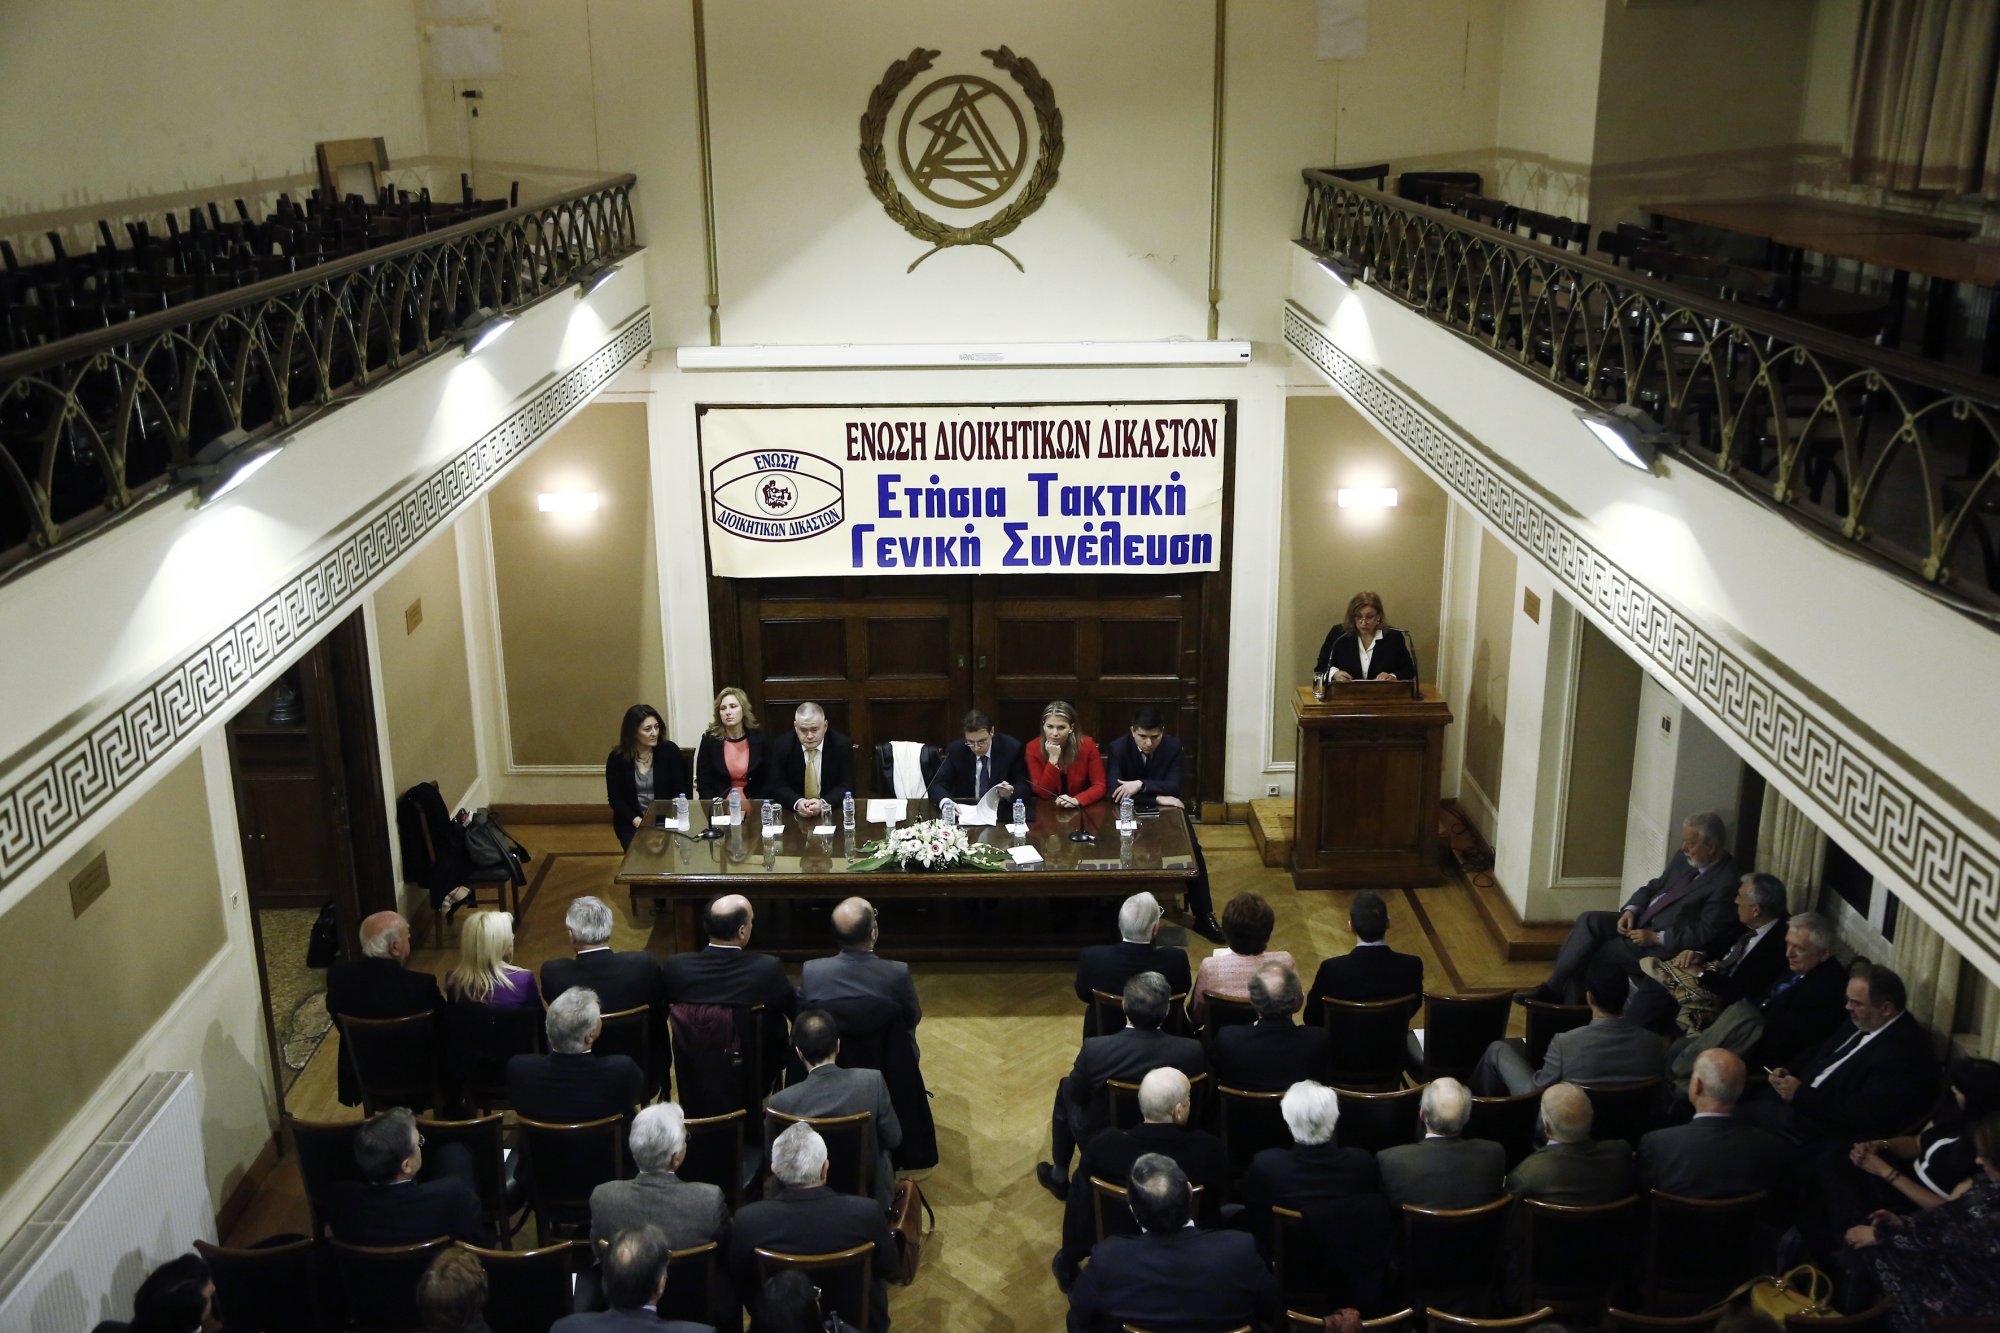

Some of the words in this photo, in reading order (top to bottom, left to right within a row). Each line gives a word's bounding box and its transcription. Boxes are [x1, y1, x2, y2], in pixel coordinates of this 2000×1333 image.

[753, 453, 800, 470] ΕΝΩΣΗ
[846, 421, 928, 462] ΕΝΩΣΗ
[934, 420, 1092, 461] ΔΙΟΙΚΗΤΙΚΩΝ
[1098, 418, 1218, 459] ΔΙΚΑΣΤΩΝ
[877, 473, 1006, 519] Ετήσια
[1027, 471, 1186, 517] Τακτική
[717, 510, 786, 537] ΔΙΟΙΚΗΤΙΚΩΝ
[788, 508, 841, 536] ΔΙΚΑΣΤΩΝ
[851, 522, 981, 568] Γενική
[1003, 521, 1213, 567] Συνέλευση
